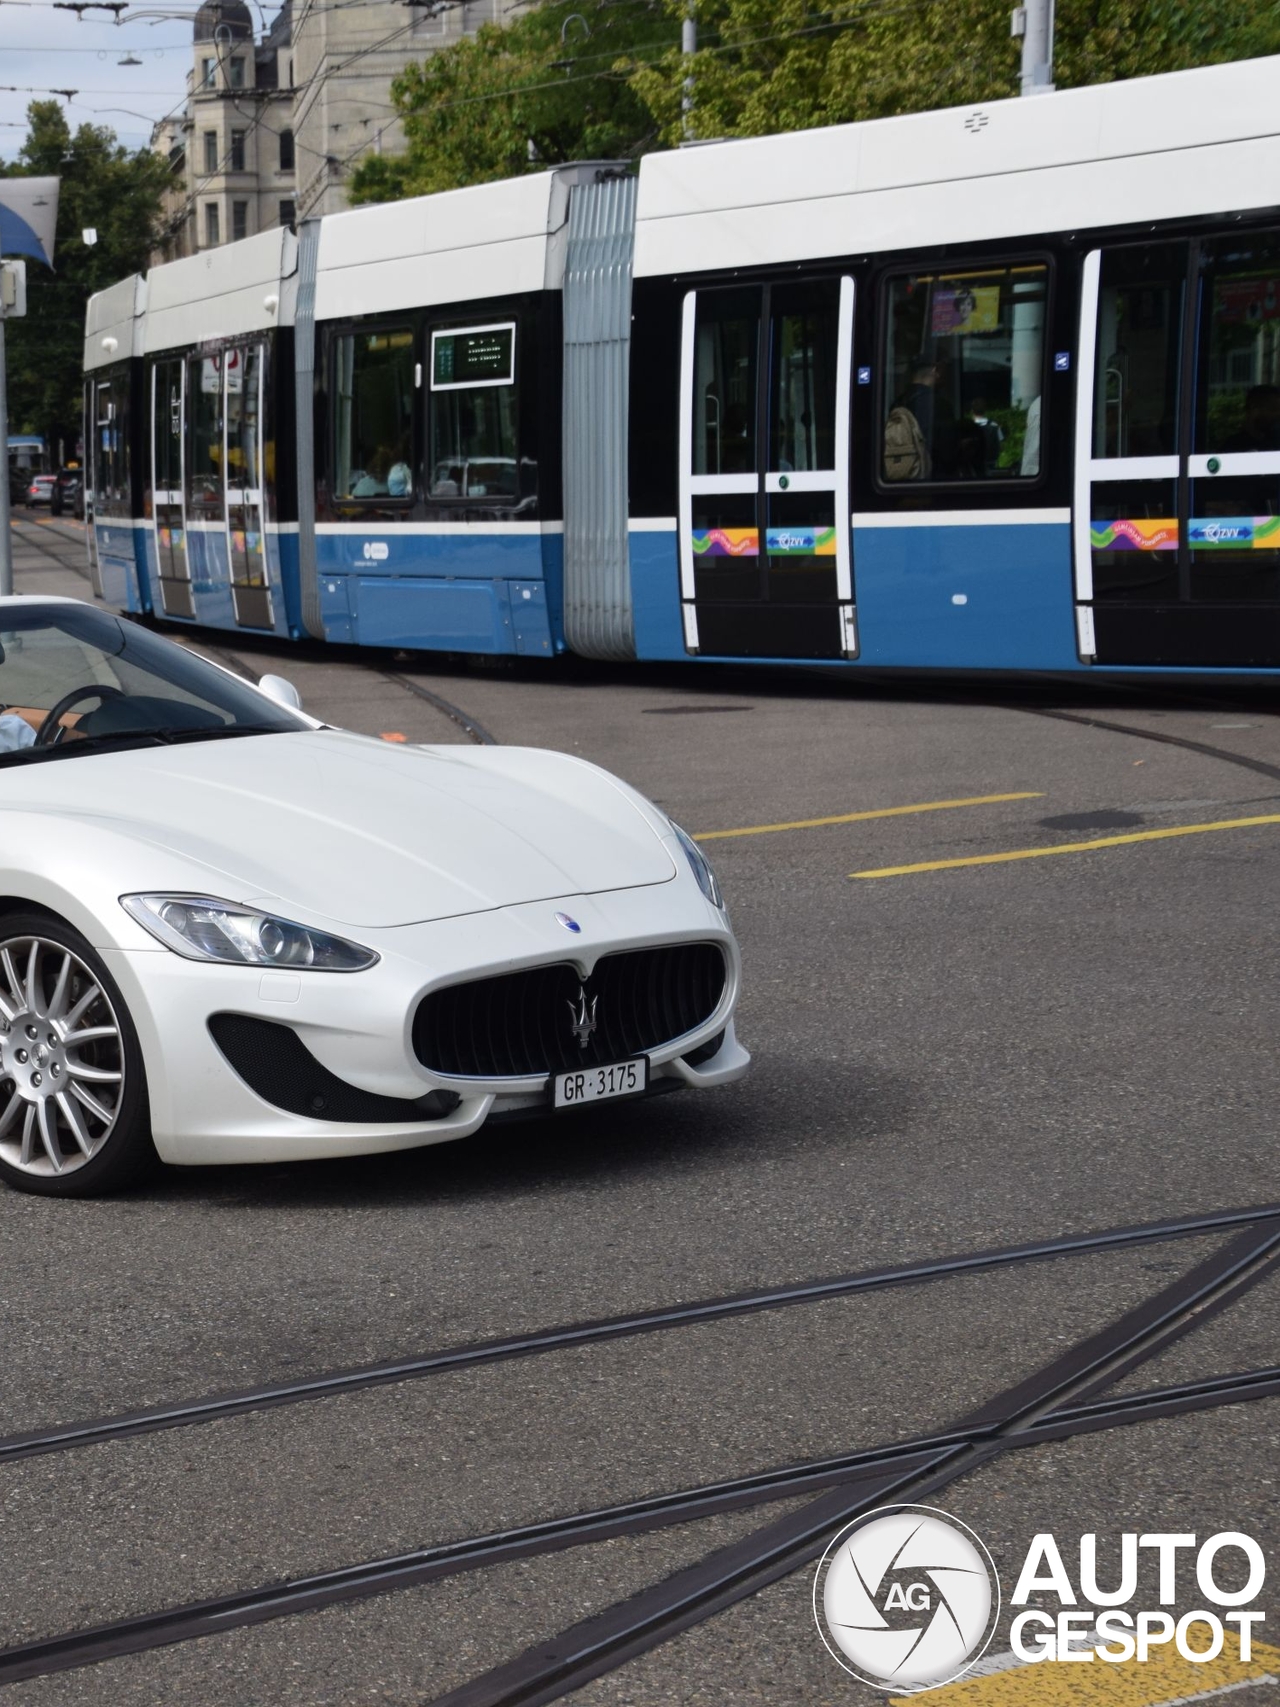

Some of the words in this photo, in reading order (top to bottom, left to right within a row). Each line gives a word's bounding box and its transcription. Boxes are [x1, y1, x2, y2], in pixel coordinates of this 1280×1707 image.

[1220, 527, 1239, 538] ZVV
[789, 537, 804, 546] ZVV
[596, 1063, 637, 1095] 3175
